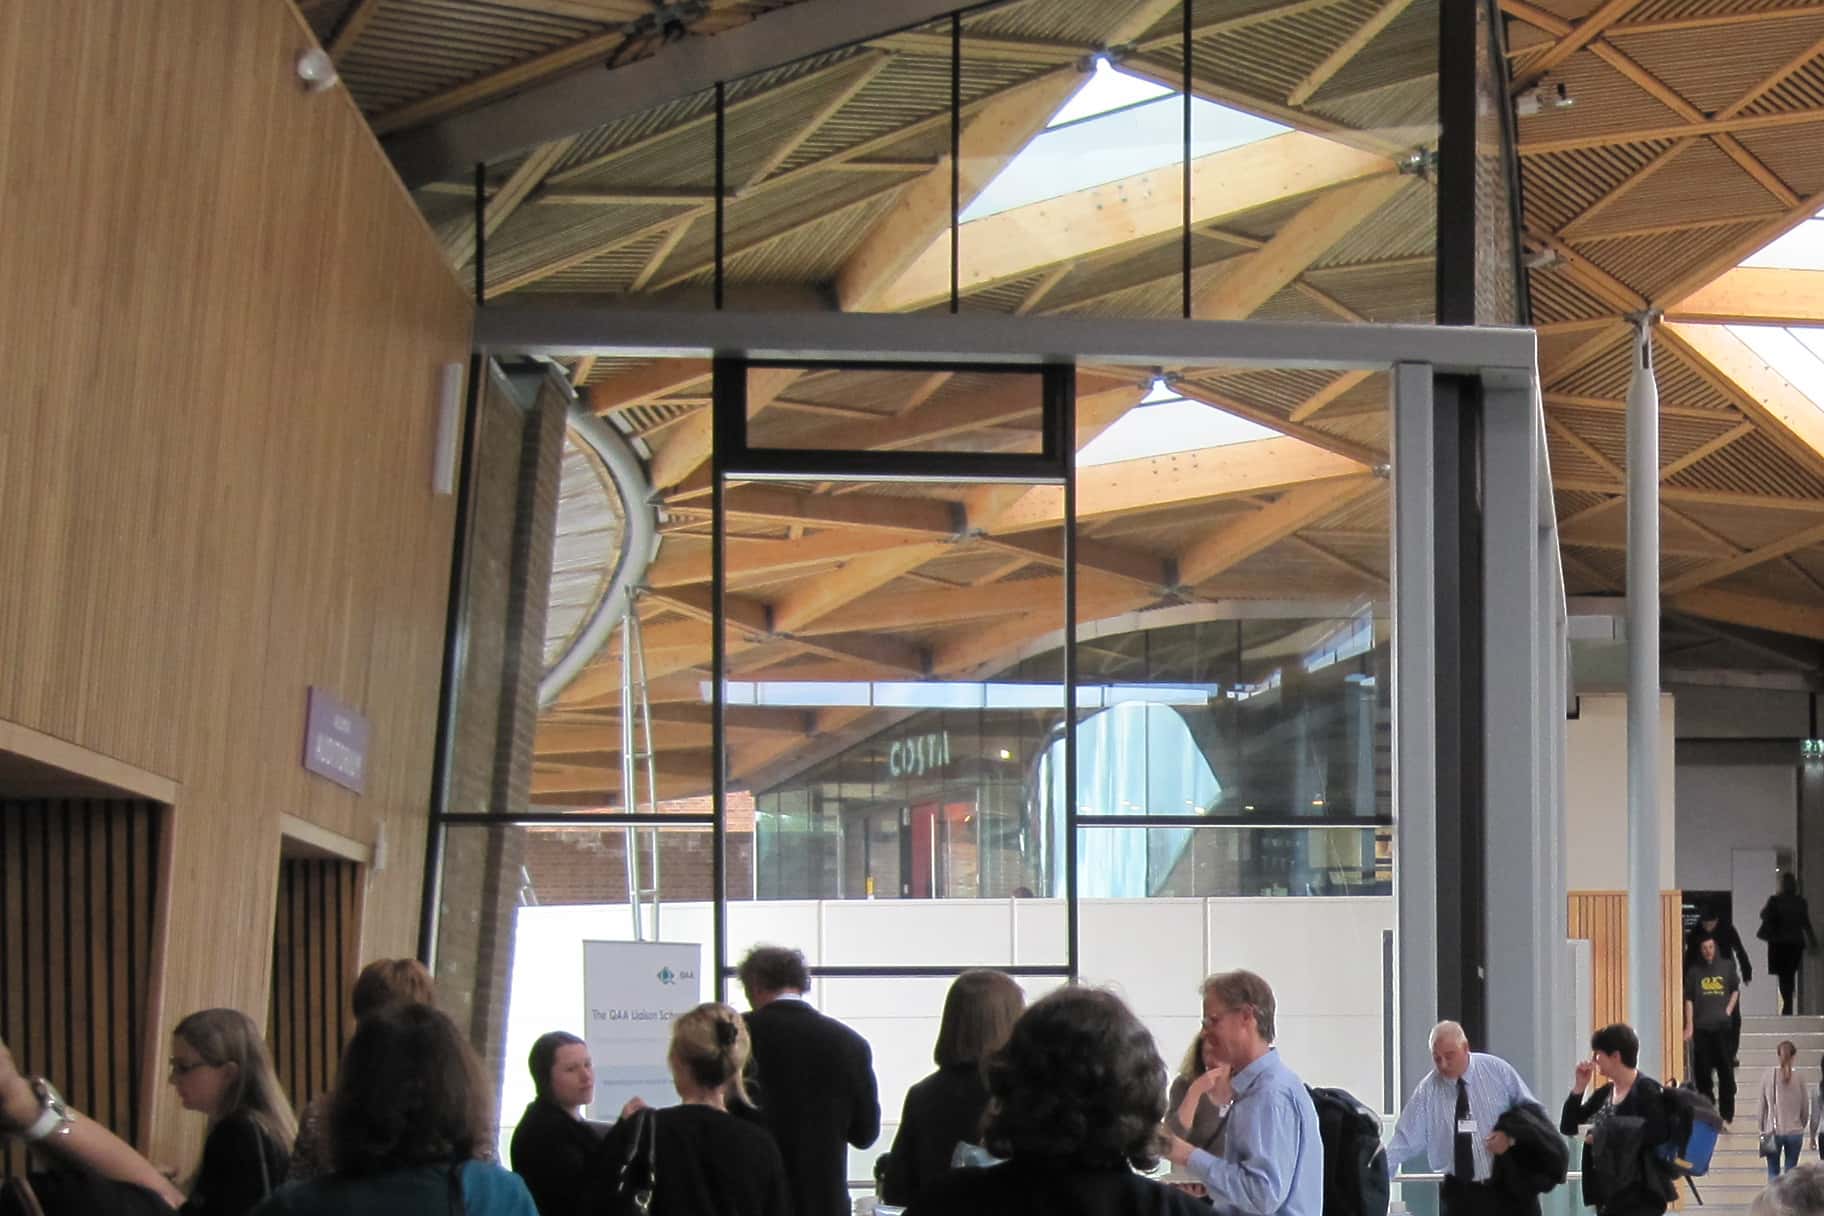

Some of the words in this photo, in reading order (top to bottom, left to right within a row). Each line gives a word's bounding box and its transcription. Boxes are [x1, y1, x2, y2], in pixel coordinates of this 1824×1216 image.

[890, 730, 950, 777] COSTA
[592, 1009, 607, 1020] The
[609, 1009, 629, 1020] QAA
